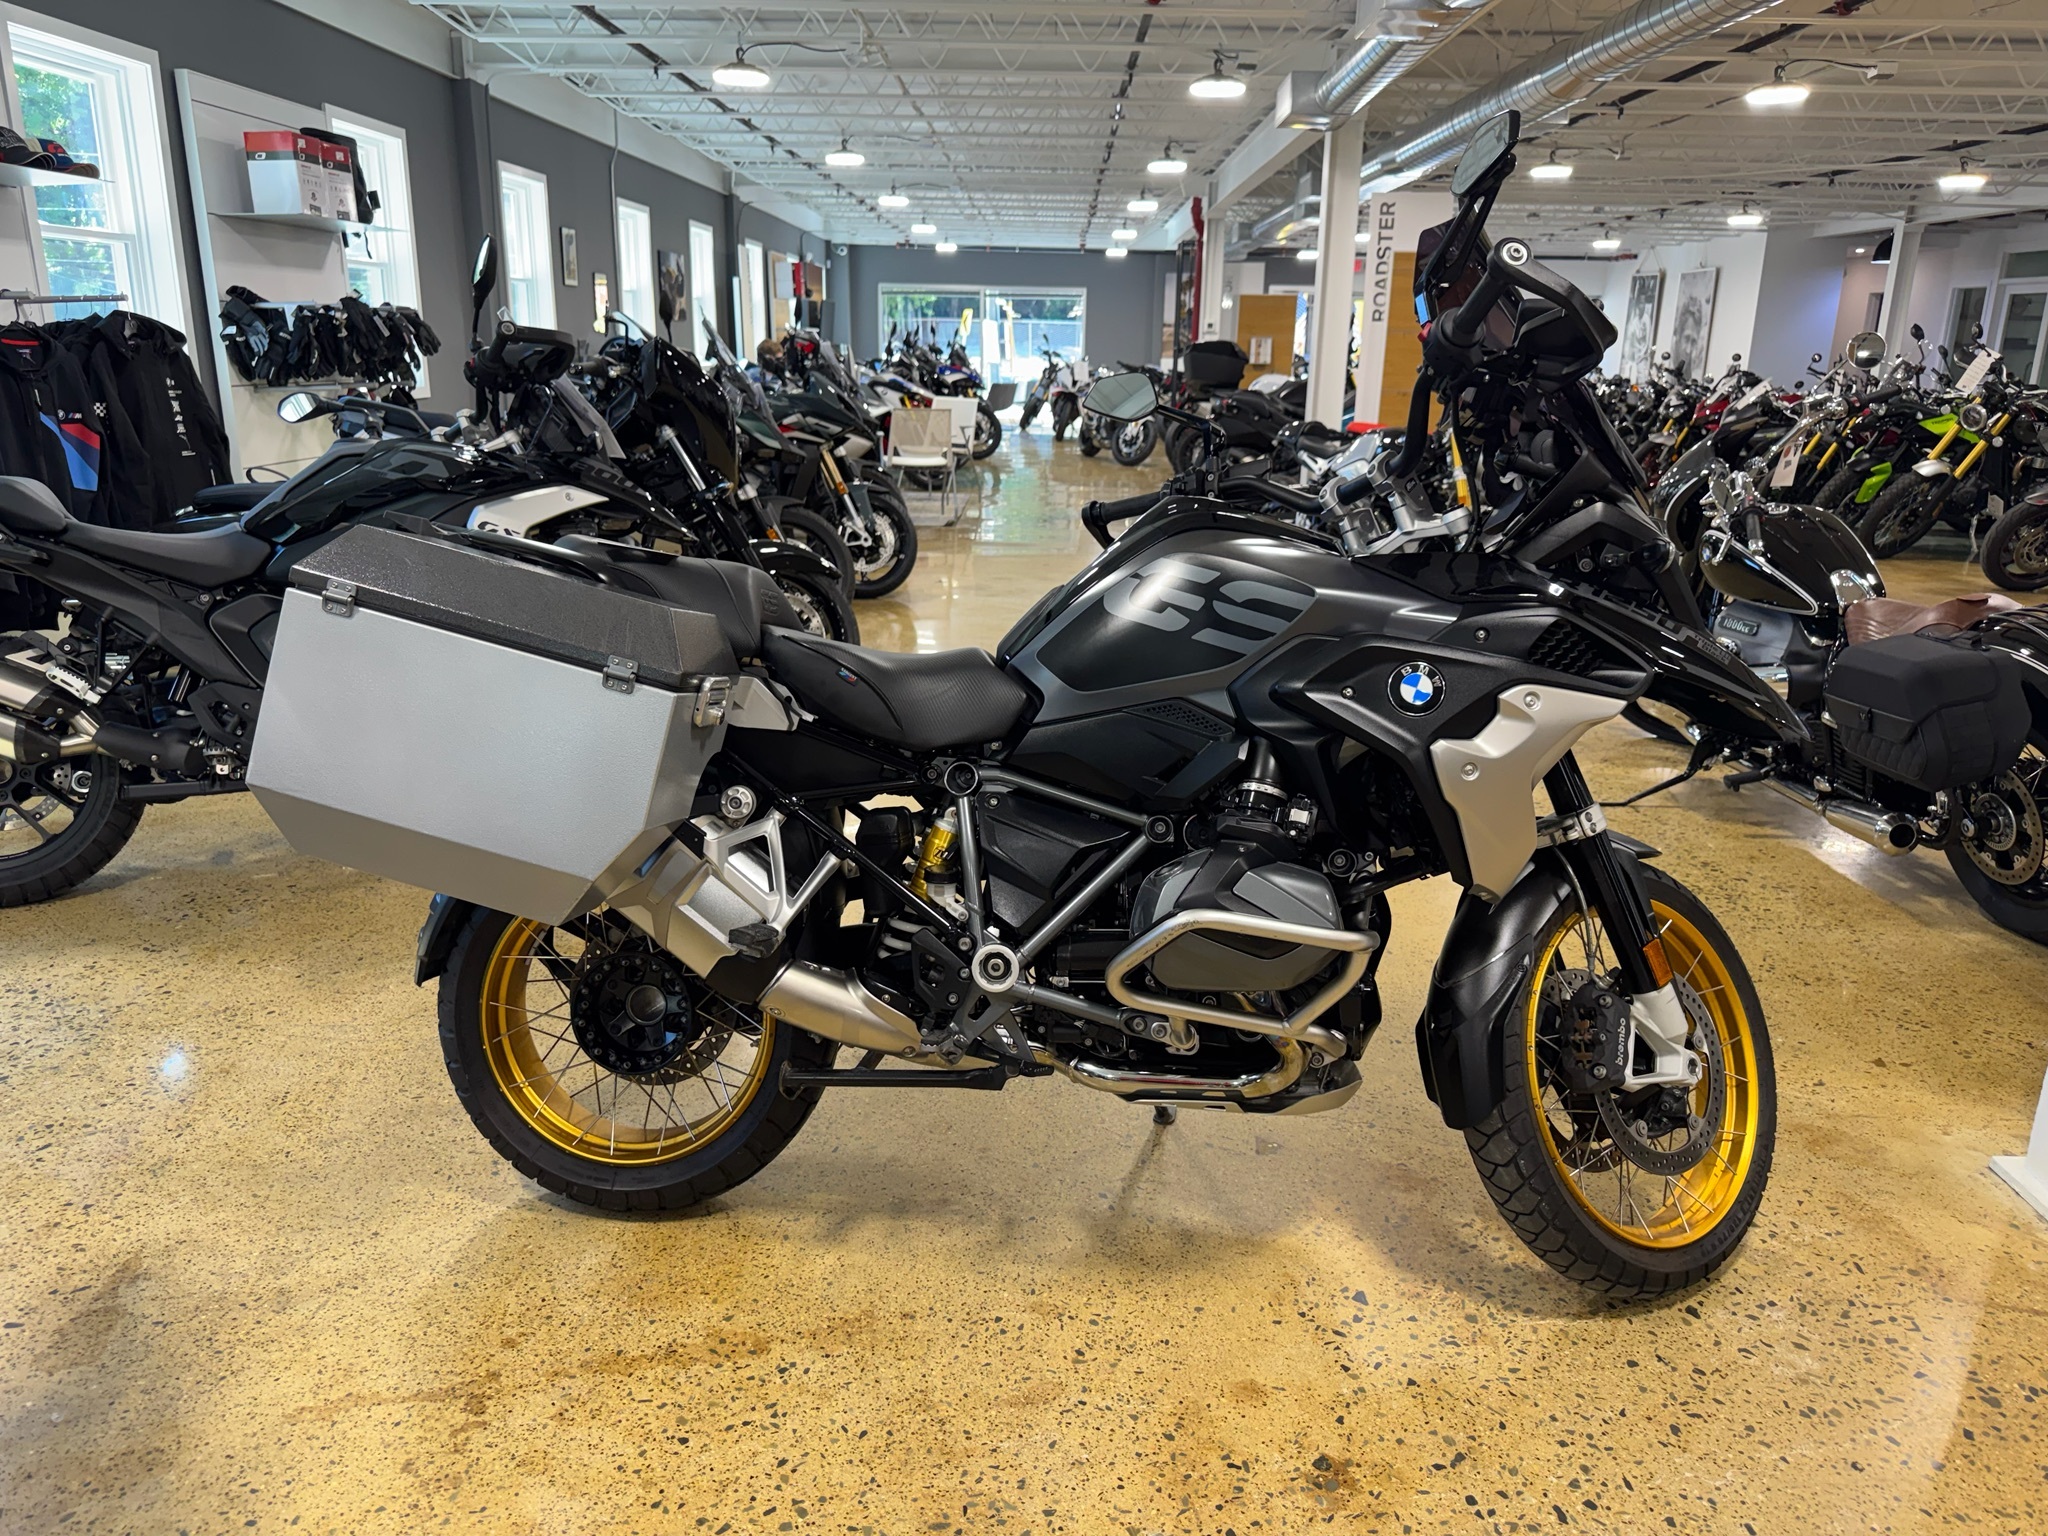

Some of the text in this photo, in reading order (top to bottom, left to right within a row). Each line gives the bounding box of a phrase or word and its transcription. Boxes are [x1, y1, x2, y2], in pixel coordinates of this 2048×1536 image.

[1371, 201, 1396, 322] ROADSTER
[1103, 558, 1317, 656] GS
[1400, 664, 1442, 687] BMW
[1615, 1017, 1626, 1066] brembo
